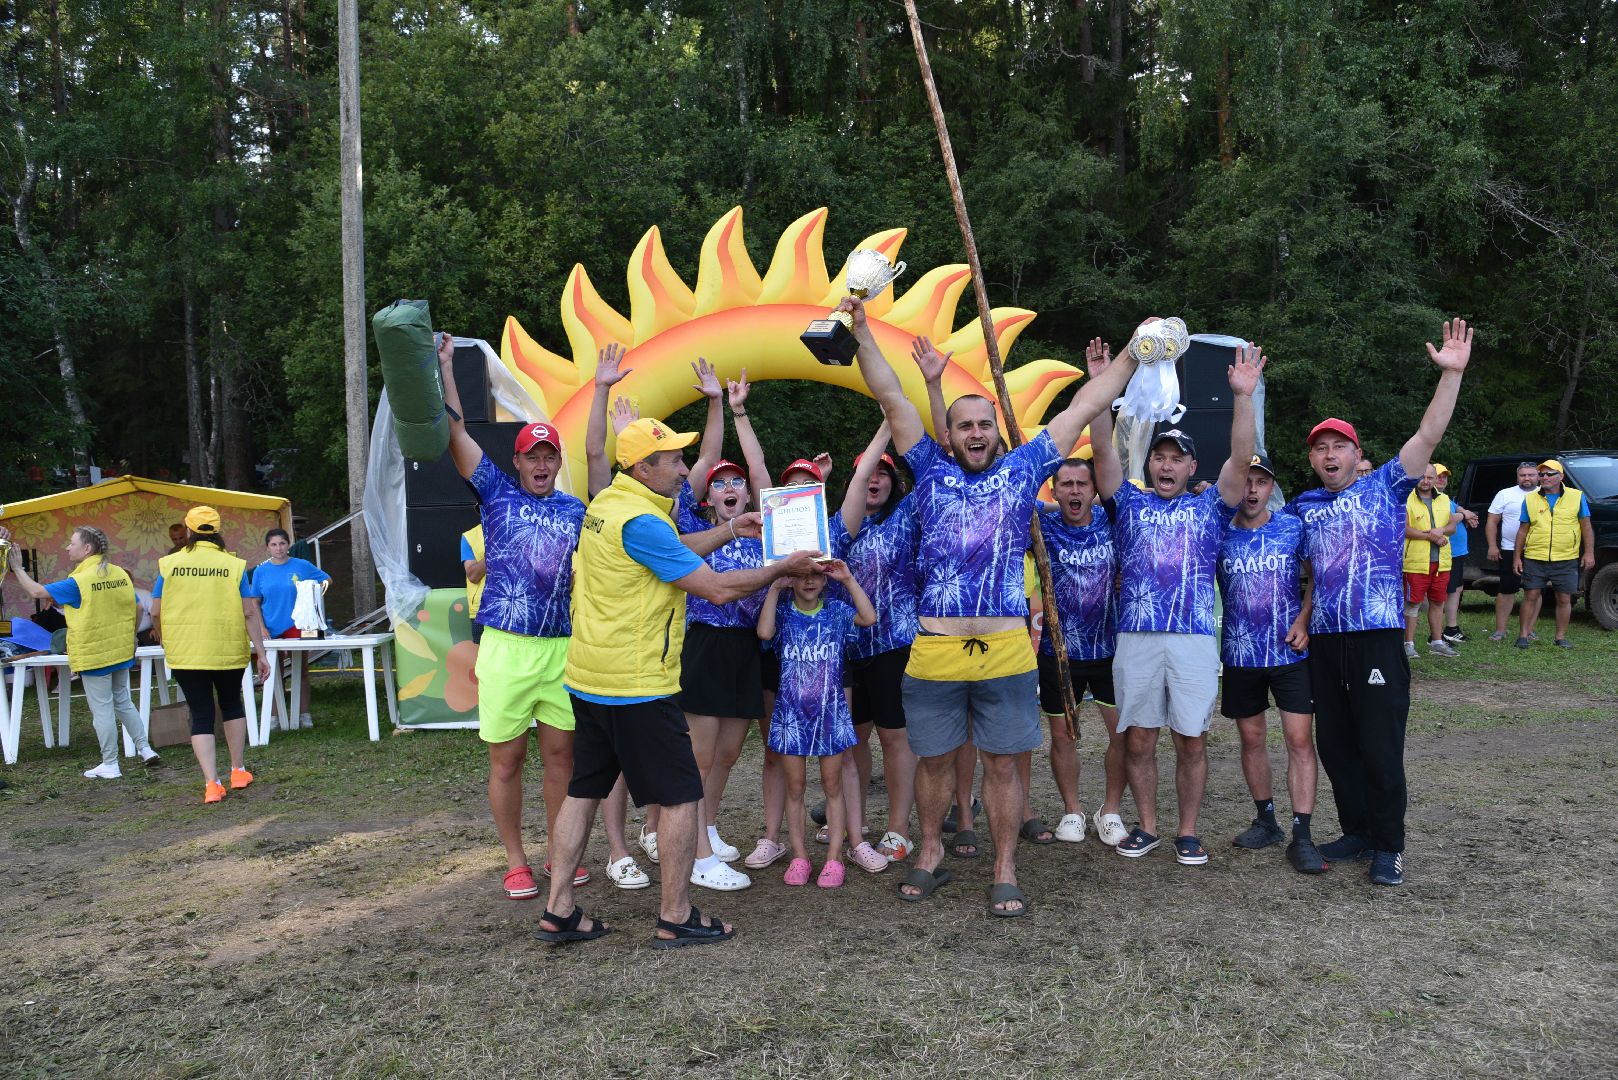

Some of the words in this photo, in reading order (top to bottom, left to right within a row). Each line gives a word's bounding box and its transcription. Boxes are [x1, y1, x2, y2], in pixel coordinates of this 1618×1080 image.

[1139, 506, 1197, 527] САЛЮТ
[1305, 493, 1362, 523] САЛЮТ
[1058, 541, 1114, 566] САЛЮТ
[1223, 553, 1289, 575] САЛЮТ
[172, 567, 229, 578] ЛОТОШИНО
[91, 578, 129, 592] ЛОТОШИНО
[783, 641, 836, 662] САЛЮТ
